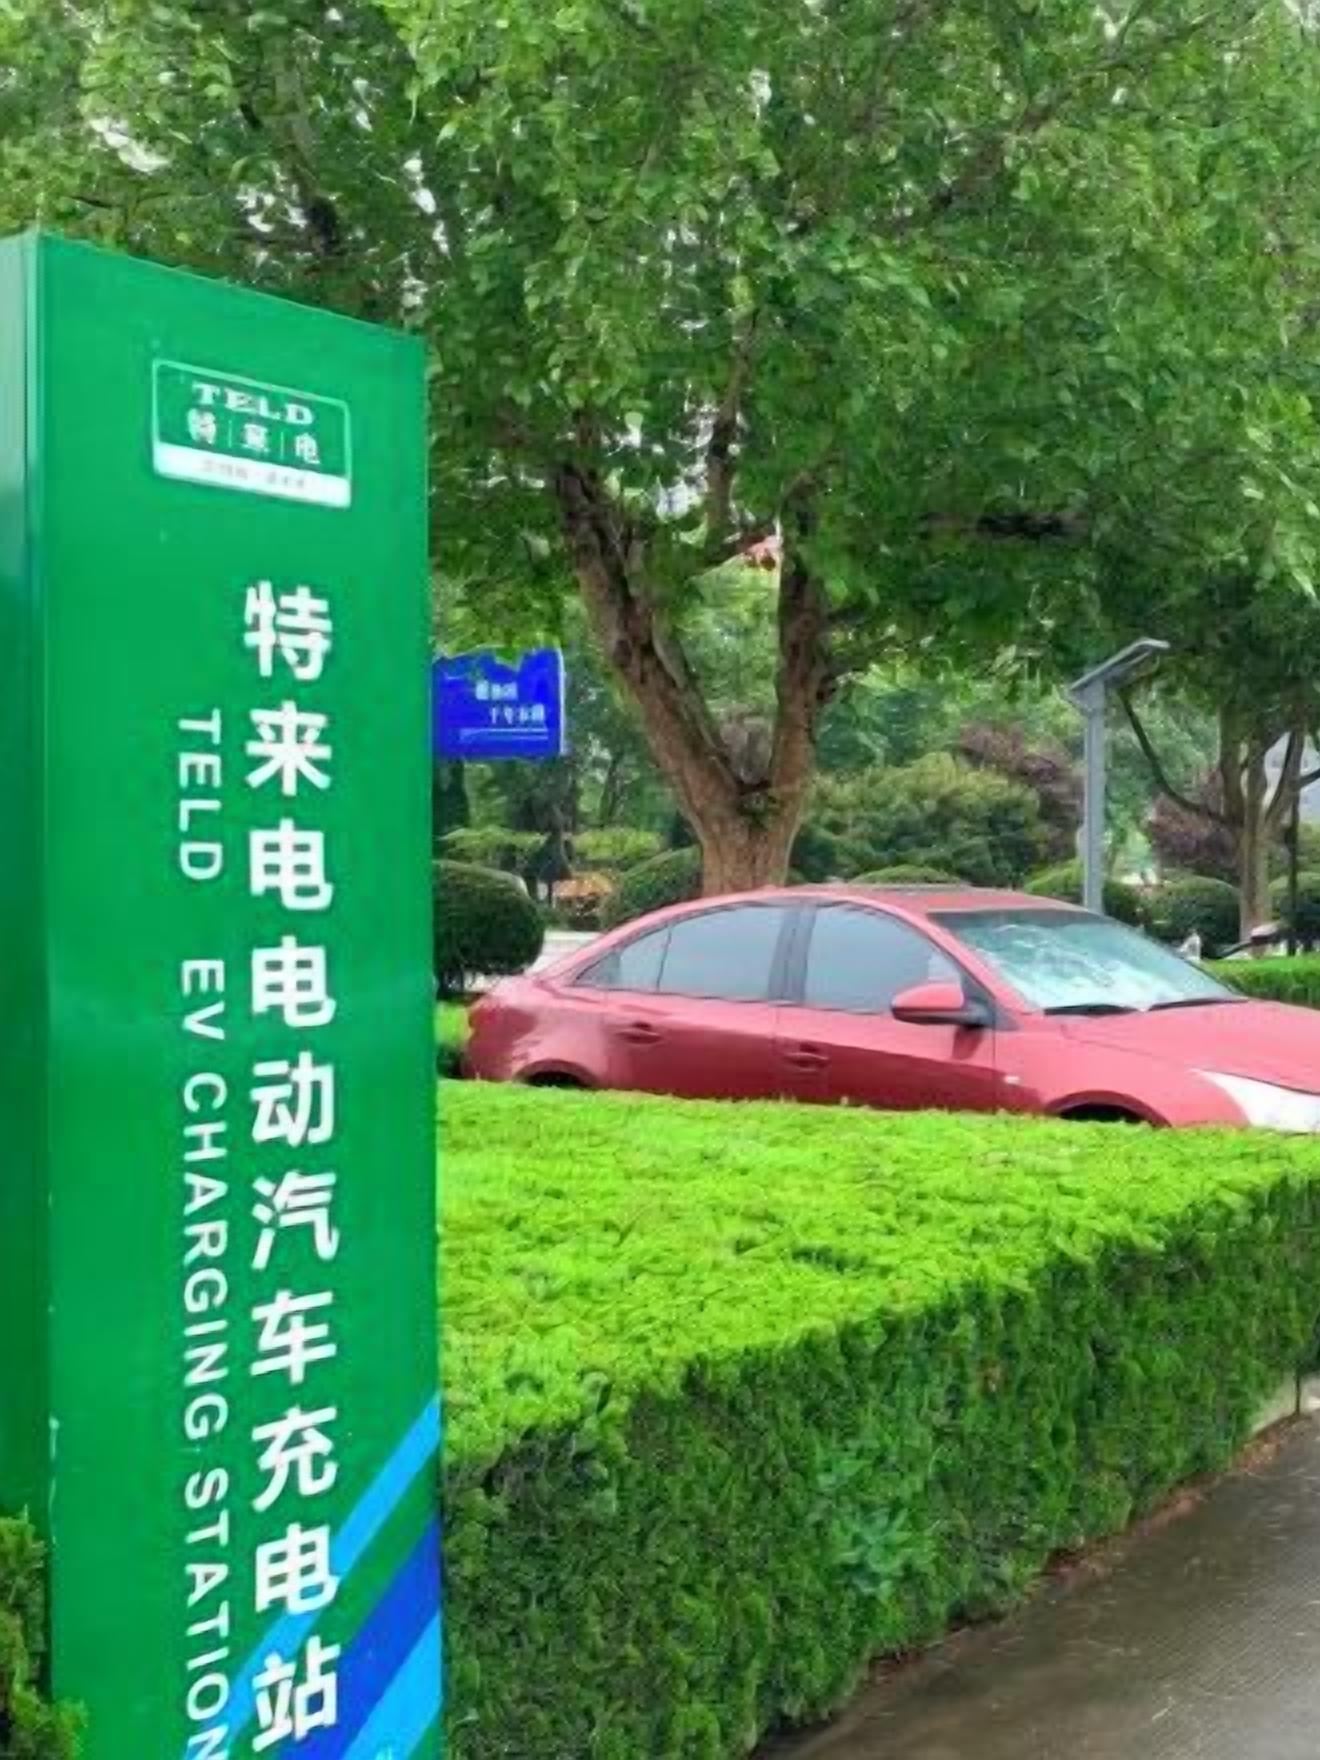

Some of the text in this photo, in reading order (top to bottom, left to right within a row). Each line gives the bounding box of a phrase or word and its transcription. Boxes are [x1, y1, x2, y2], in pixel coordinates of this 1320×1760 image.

[192, 381, 314, 425] TELD
[179, 708, 230, 1760] TELD EV CHARGING STATION
[243, 580, 341, 1752] 特来电电动汽车充电站
